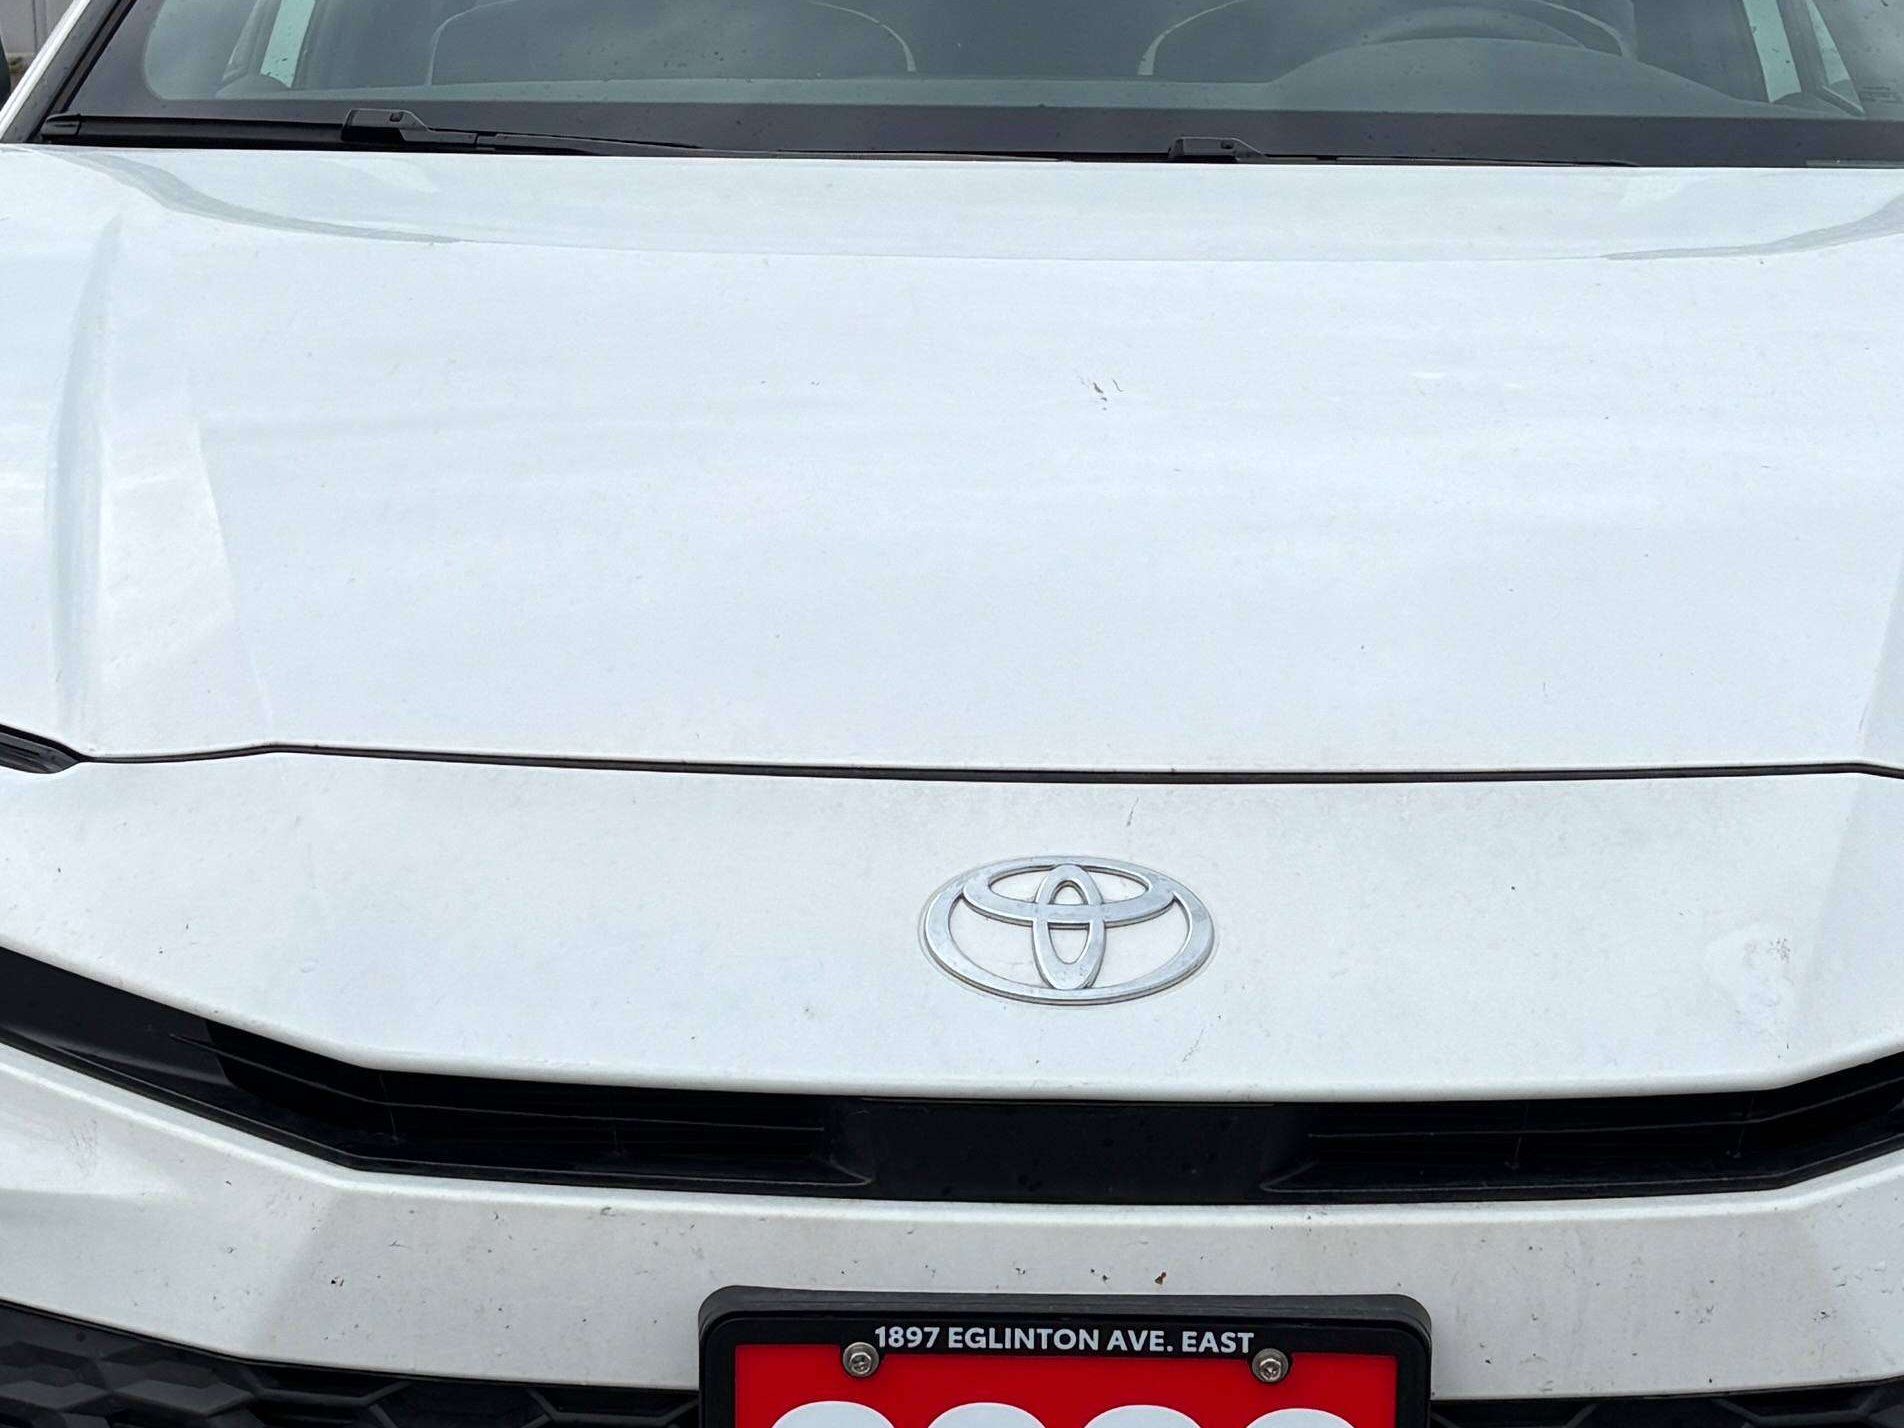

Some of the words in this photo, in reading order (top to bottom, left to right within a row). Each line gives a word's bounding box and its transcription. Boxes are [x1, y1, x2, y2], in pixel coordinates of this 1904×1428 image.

[875, 1326, 938, 1350] 1897
[948, 1327, 1099, 1351] EGLINTON
[1106, 1329, 1174, 1353] AVE.
[1182, 1330, 1255, 1354] EAST
